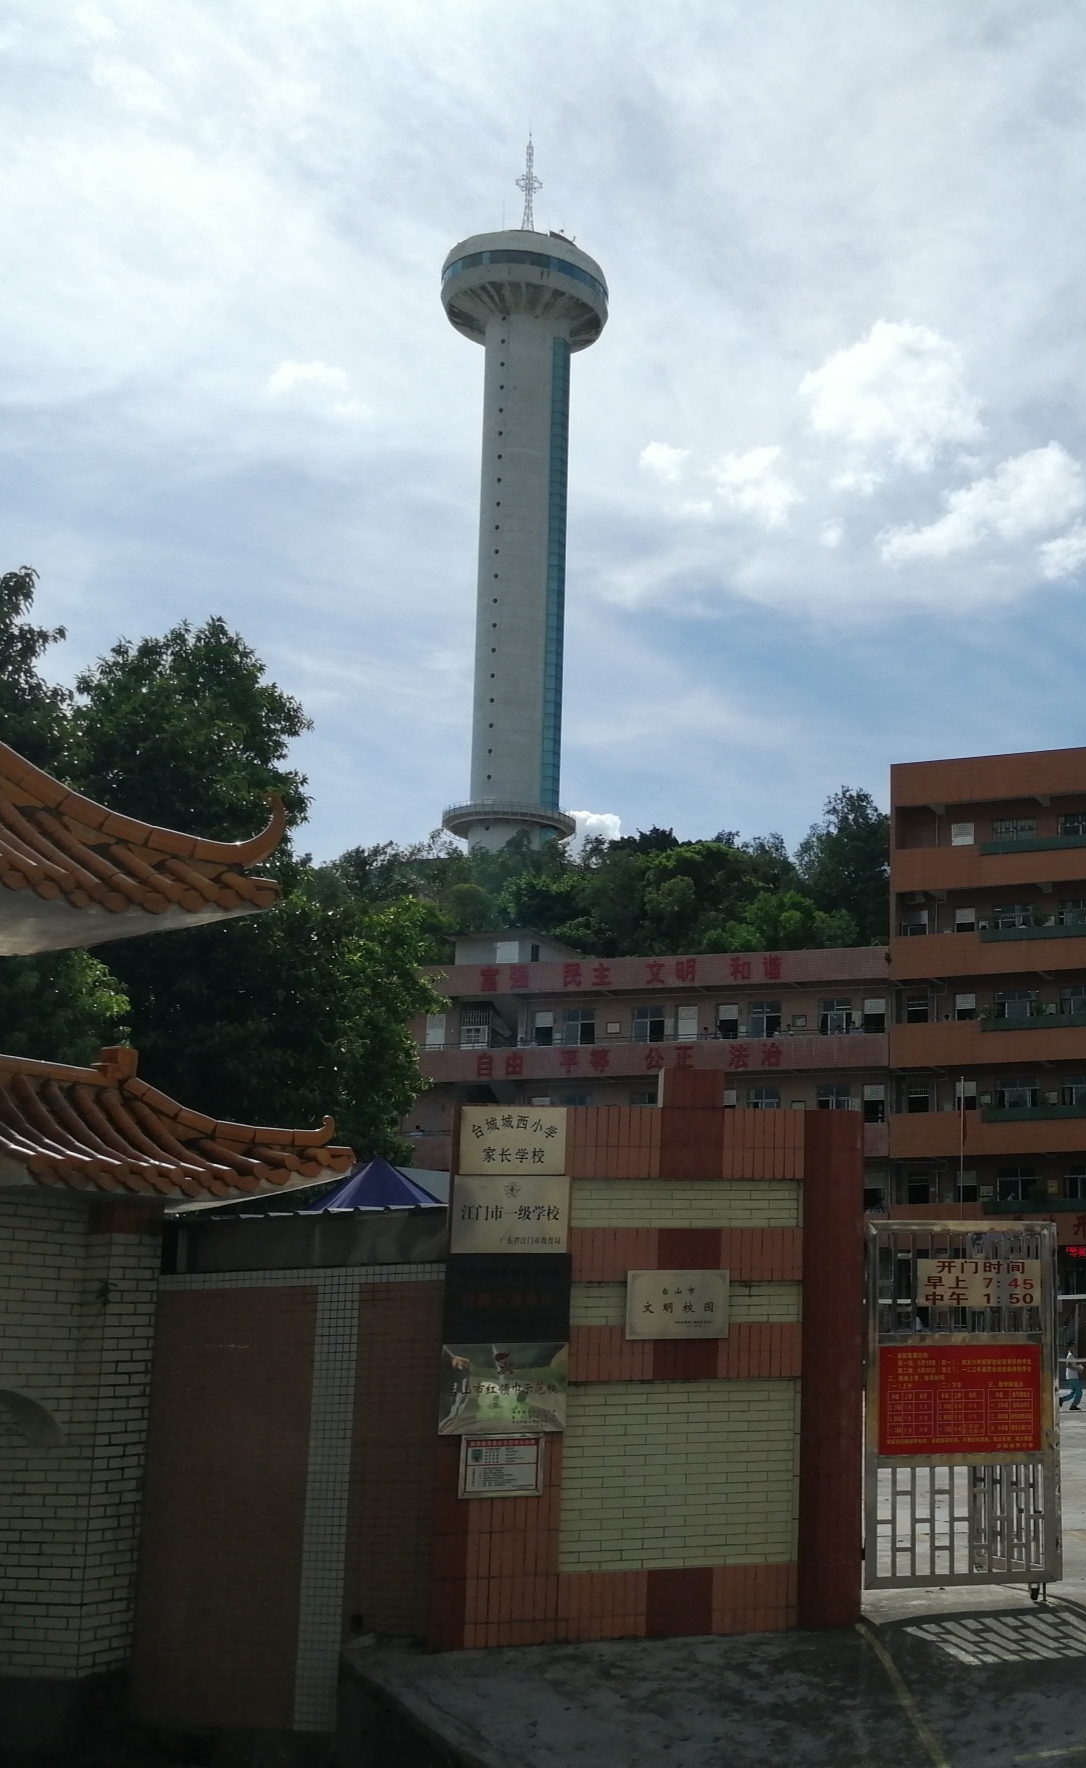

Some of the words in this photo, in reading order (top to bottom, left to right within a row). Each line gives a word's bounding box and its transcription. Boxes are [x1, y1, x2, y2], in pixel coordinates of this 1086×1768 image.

[480, 964, 529, 992] 富强
[563, 962, 611, 987] 民主
[646, 958, 696, 985] 文明
[730, 954, 782, 981] 和谐
[477, 1051, 524, 1078] 自由
[560, 1049, 610, 1073] 平等
[644, 1045, 694, 1070] 公正
[728, 1042, 782, 1068] 法治
[471, 1114, 558, 1139] 台城城西小学
[481, 1146, 546, 1164] 家长学校
[461, 1204, 560, 1221] 江门市一级学校
[936, 1260, 1025, 1274] 开门时间
[924, 1276, 968, 1289] 早上
[983, 1277, 1034, 1289] 7:45
[662, 1287, 696, 1295] 台山市
[925, 1291, 968, 1305] 中午
[983, 1293, 1034, 1304] 1:50
[642, 1301, 714, 1314] 文明校园
